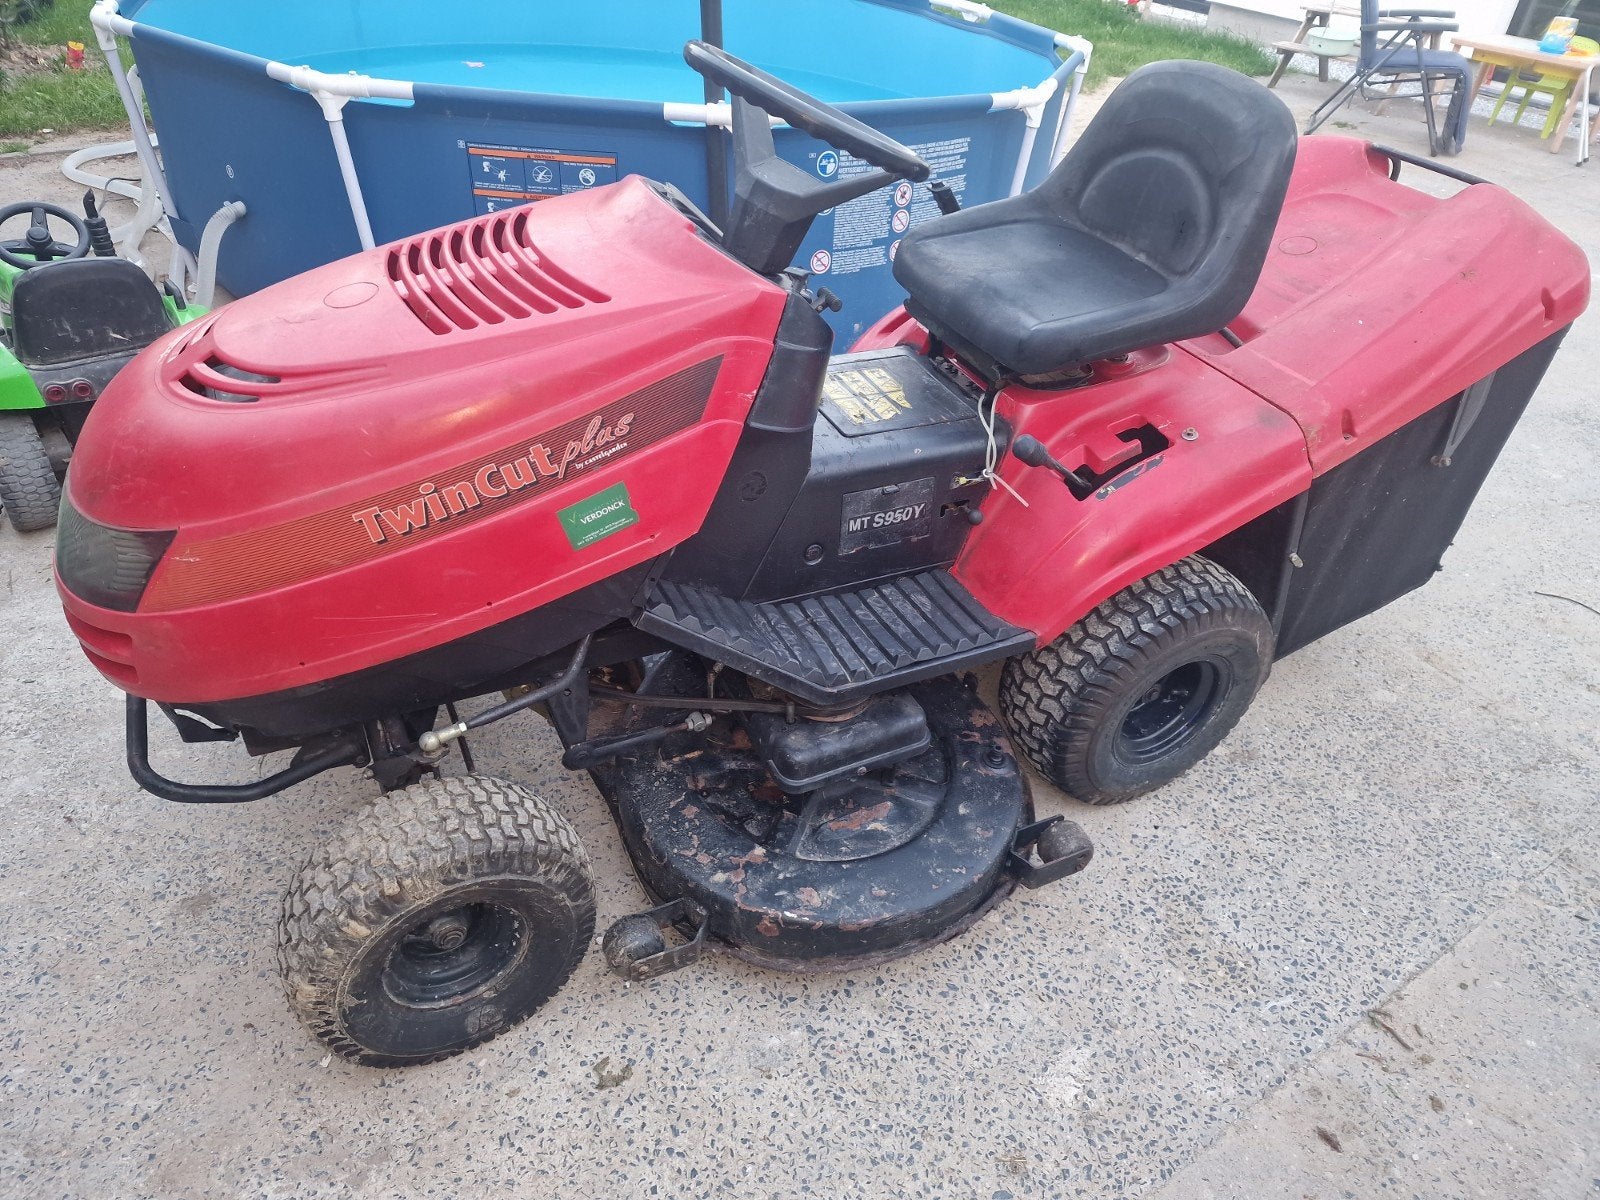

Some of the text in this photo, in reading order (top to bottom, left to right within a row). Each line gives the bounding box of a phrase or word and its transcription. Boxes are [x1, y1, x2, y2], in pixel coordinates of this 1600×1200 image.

[352, 412, 635, 543] TwinCut plus
[575, 462, 584, 470] by
[580, 499, 626, 525] VERDONCK
[849, 502, 926, 532] MT S950Y
